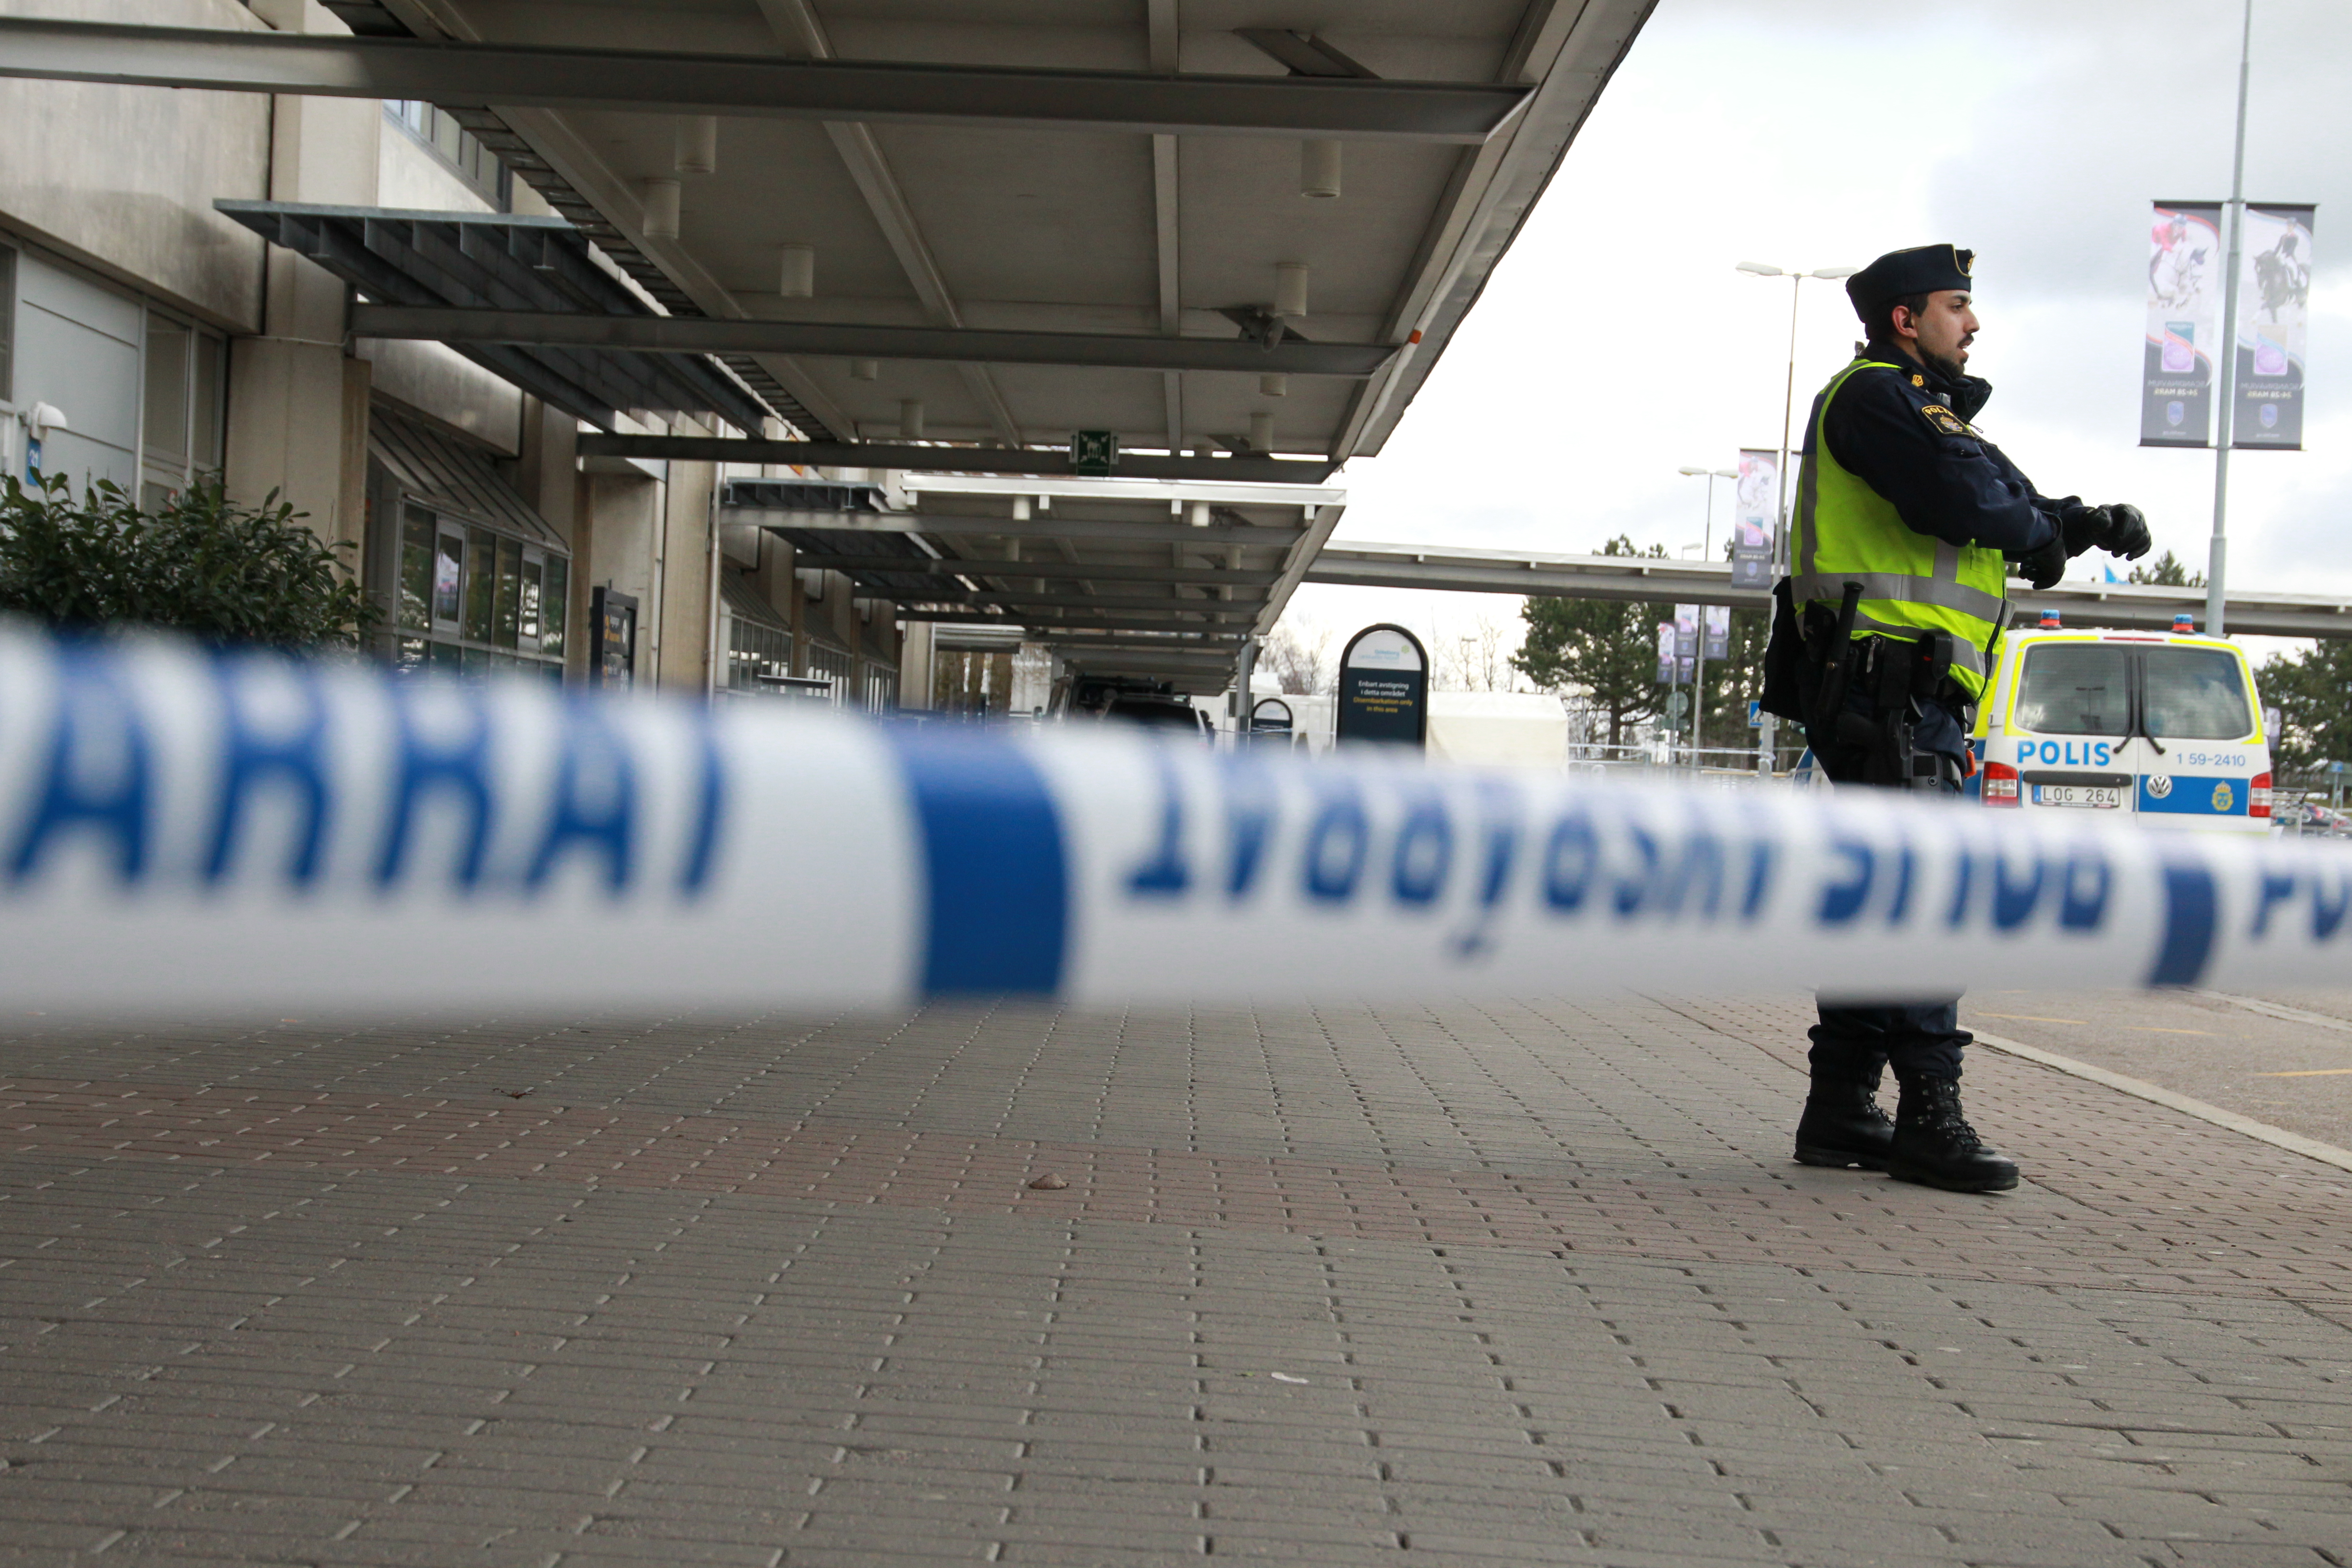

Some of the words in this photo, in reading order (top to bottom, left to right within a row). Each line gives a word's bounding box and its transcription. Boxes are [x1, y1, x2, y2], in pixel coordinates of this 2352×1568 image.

[1924, 407, 1954, 417] POLI
[1378, 682, 1409, 691] avstigning
[2017, 740, 2111, 766] POLIS
[2177, 753, 2182, 764] 1
[2189, 753, 2246, 767] 59-2410
[2043, 786, 2073, 801] LOG
[2085, 788, 2116, 803] 264
